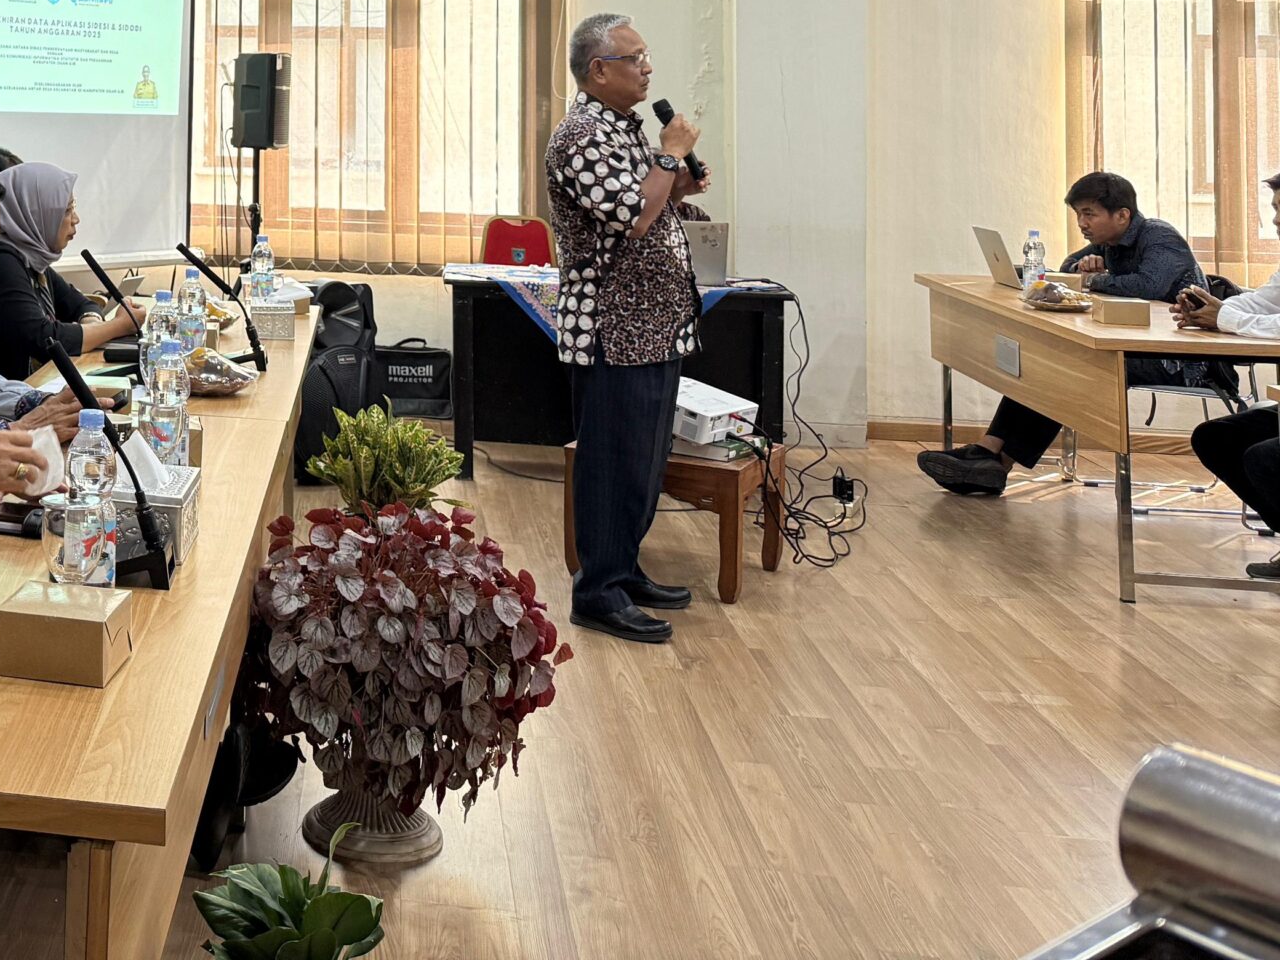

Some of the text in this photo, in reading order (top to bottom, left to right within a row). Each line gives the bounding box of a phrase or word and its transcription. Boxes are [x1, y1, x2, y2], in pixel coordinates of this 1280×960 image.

[27, 17, 49, 27] DATA
[50, 20, 86, 29] APLIKASI
[87, 21, 110, 30] SIDESI
[10, 25, 101, 38] TAHUN ANGGARAN 2025
[388, 364, 433, 376] maxell
